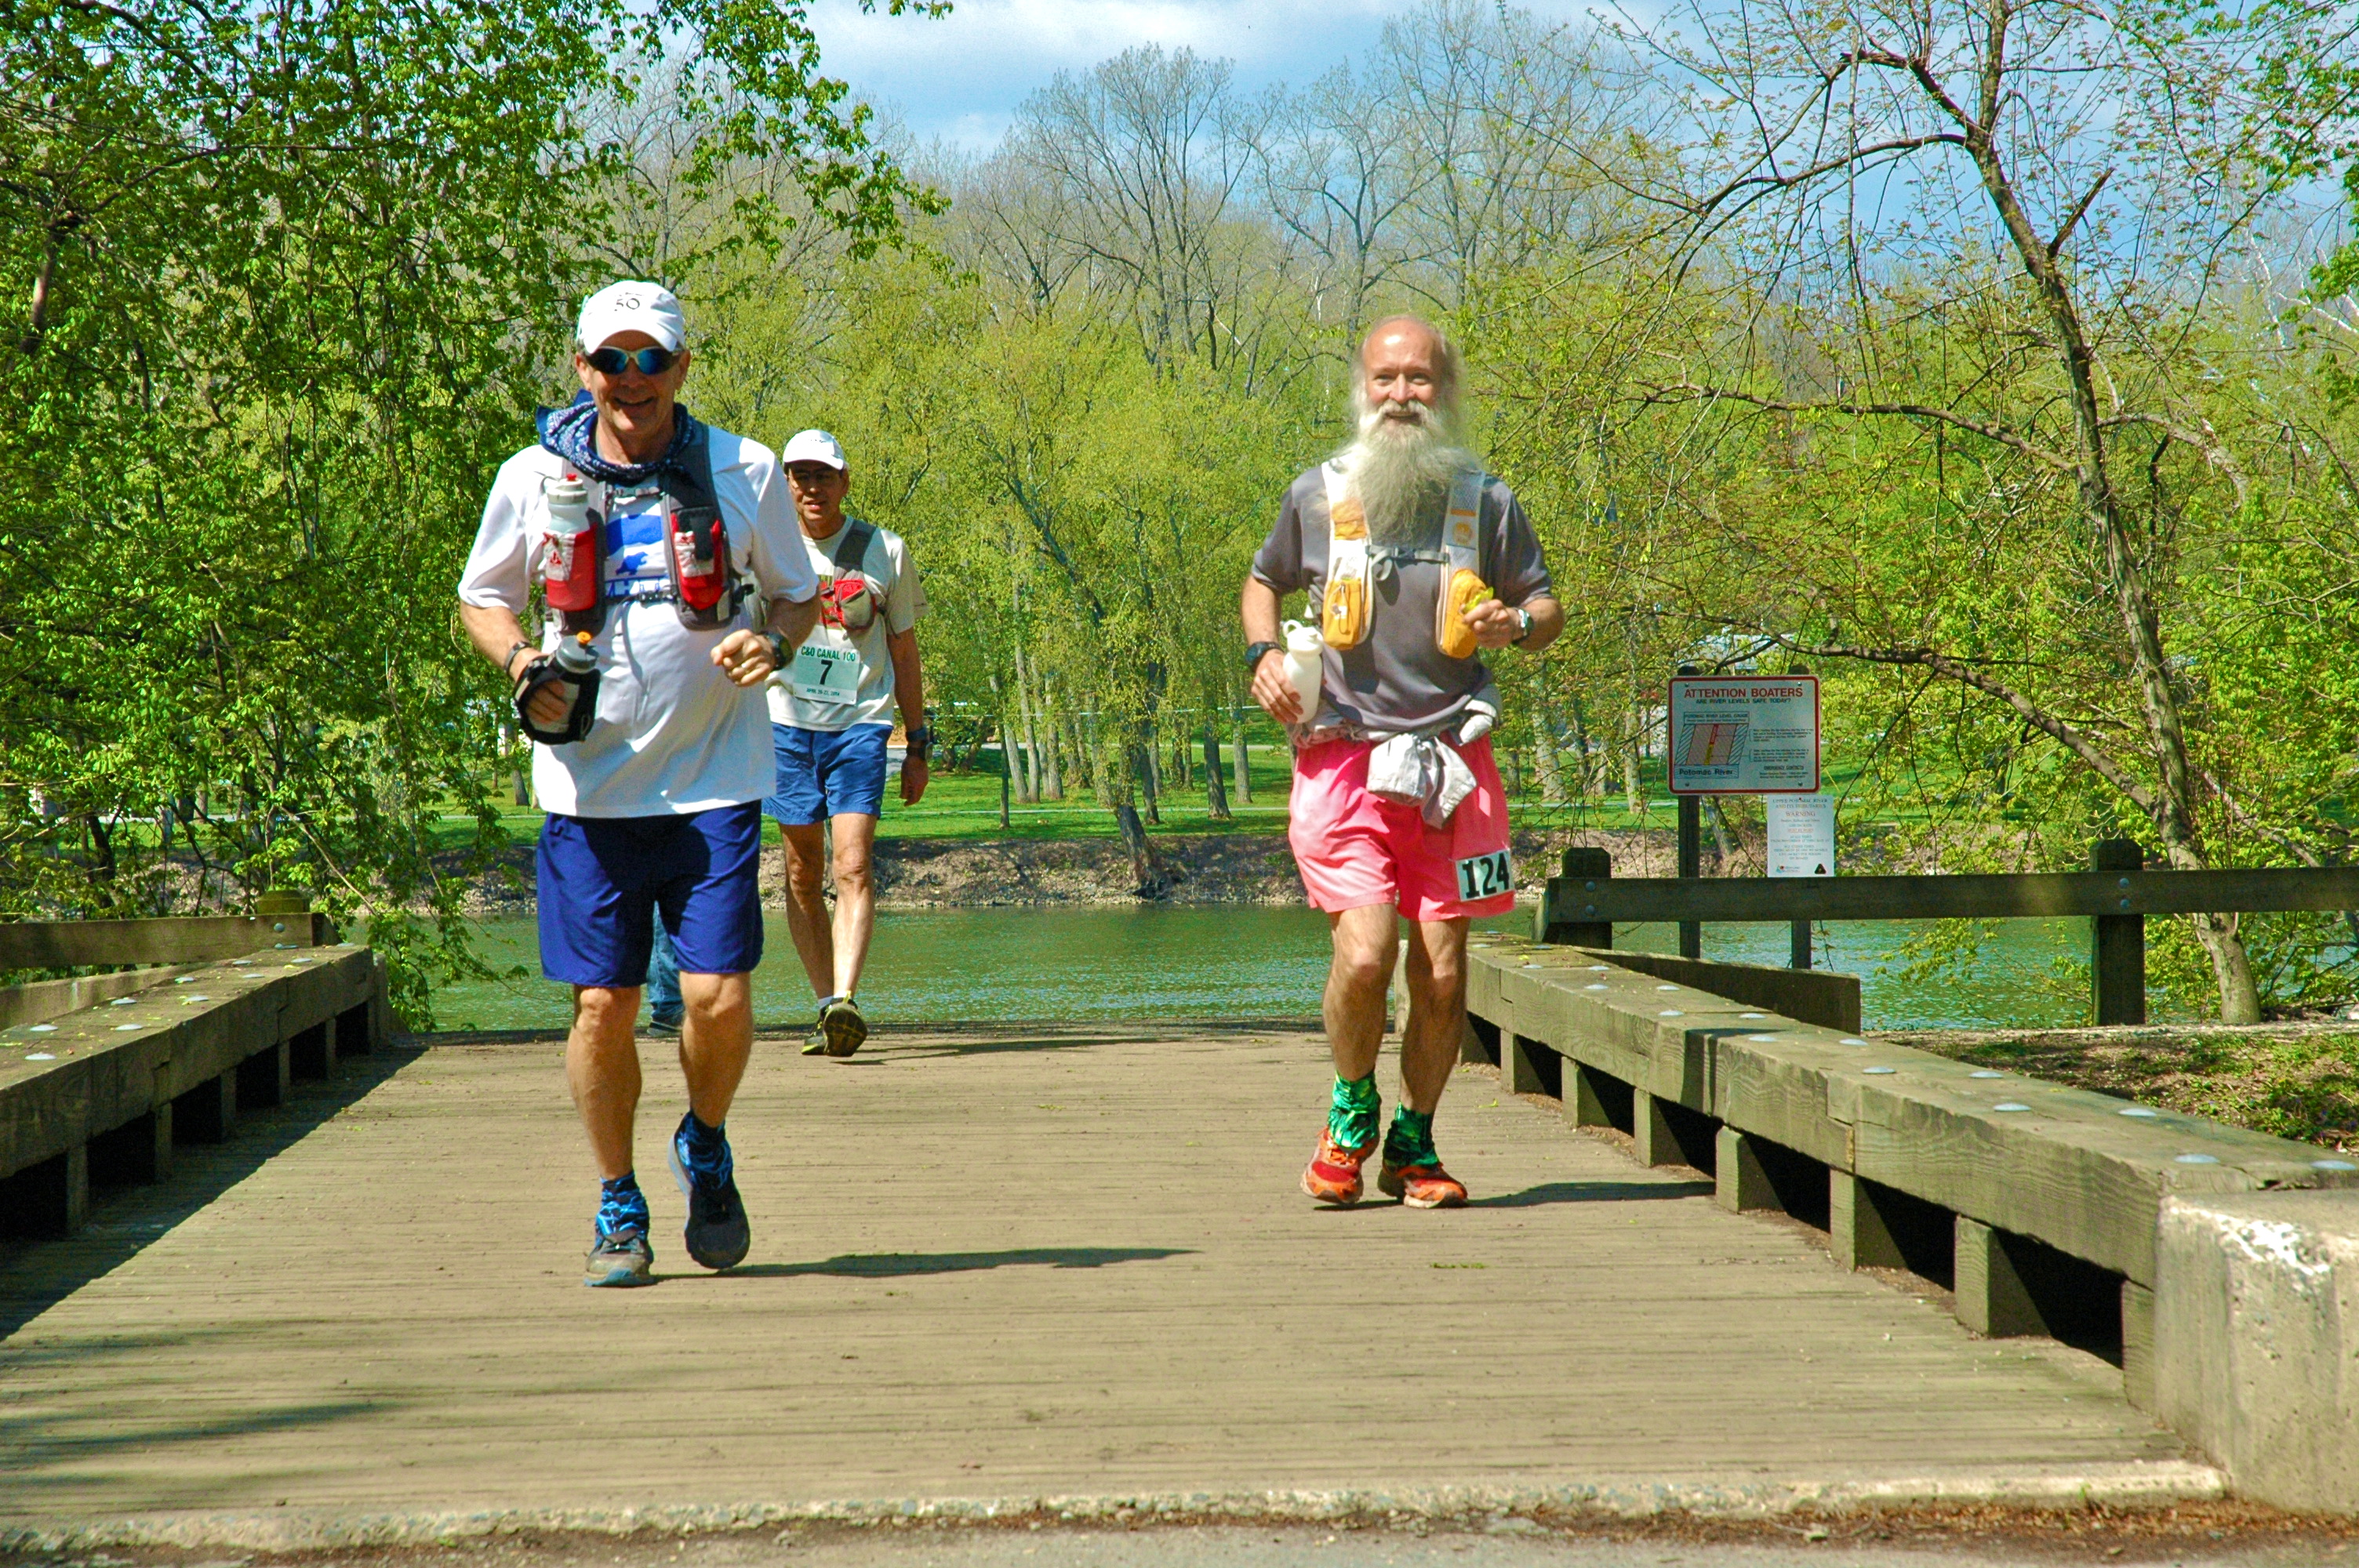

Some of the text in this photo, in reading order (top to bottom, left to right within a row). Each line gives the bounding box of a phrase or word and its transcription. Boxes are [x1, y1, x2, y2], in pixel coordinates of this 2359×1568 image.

[614, 297, 641, 312] 50
[801, 646, 856, 662] C&O CANAL 100
[820, 659, 833, 685] 7
[1684, 688, 1803, 699] ATTENTION BOATERS
[1462, 853, 1510, 899] 124
